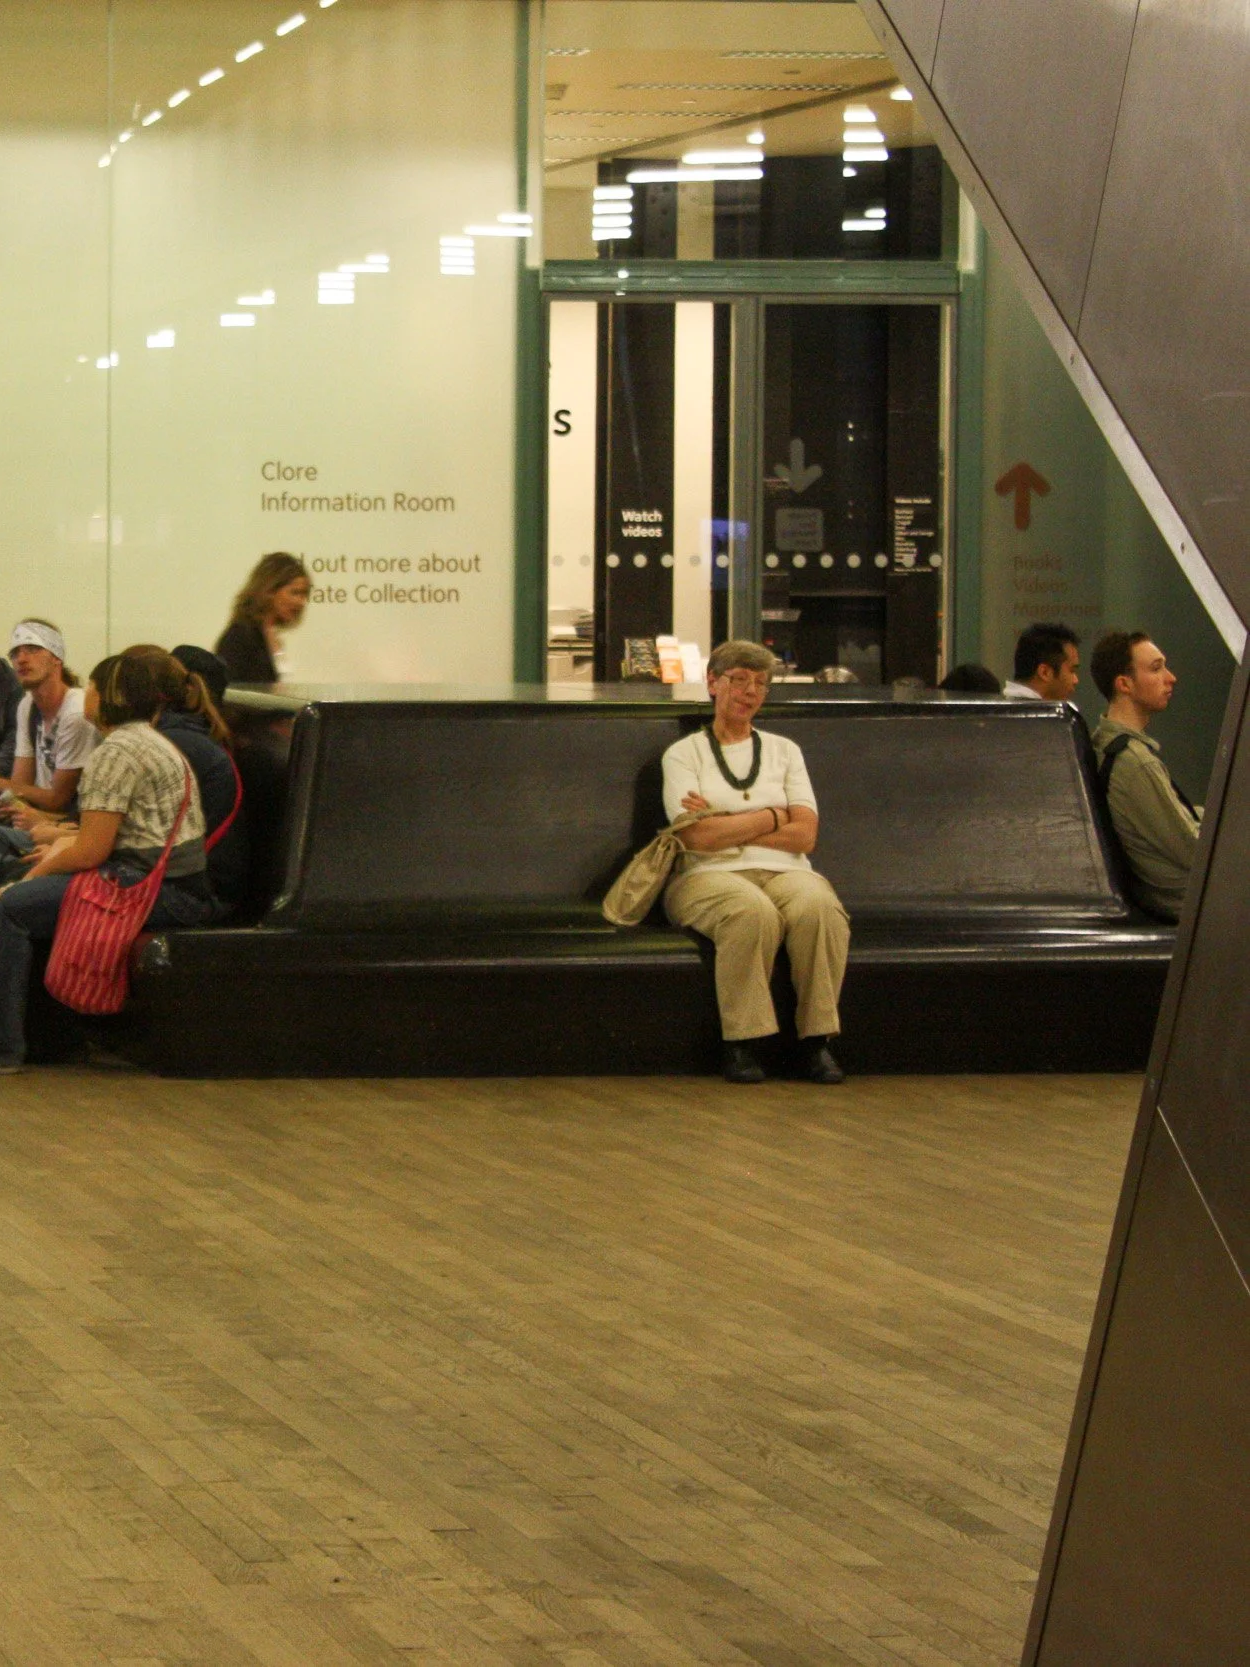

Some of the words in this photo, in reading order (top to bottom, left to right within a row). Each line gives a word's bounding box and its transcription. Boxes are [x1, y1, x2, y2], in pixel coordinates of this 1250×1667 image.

[261, 461, 318, 481] Clore
[261, 491, 386, 512] Information
[393, 492, 456, 512] Room
[621, 509, 663, 523] Watch
[621, 525, 663, 538] videos
[311, 554, 347, 573] out
[354, 556, 411, 573] more
[418, 552, 481, 573] about
[307, 584, 347, 603] ate
[354, 582, 460, 603] Collection
